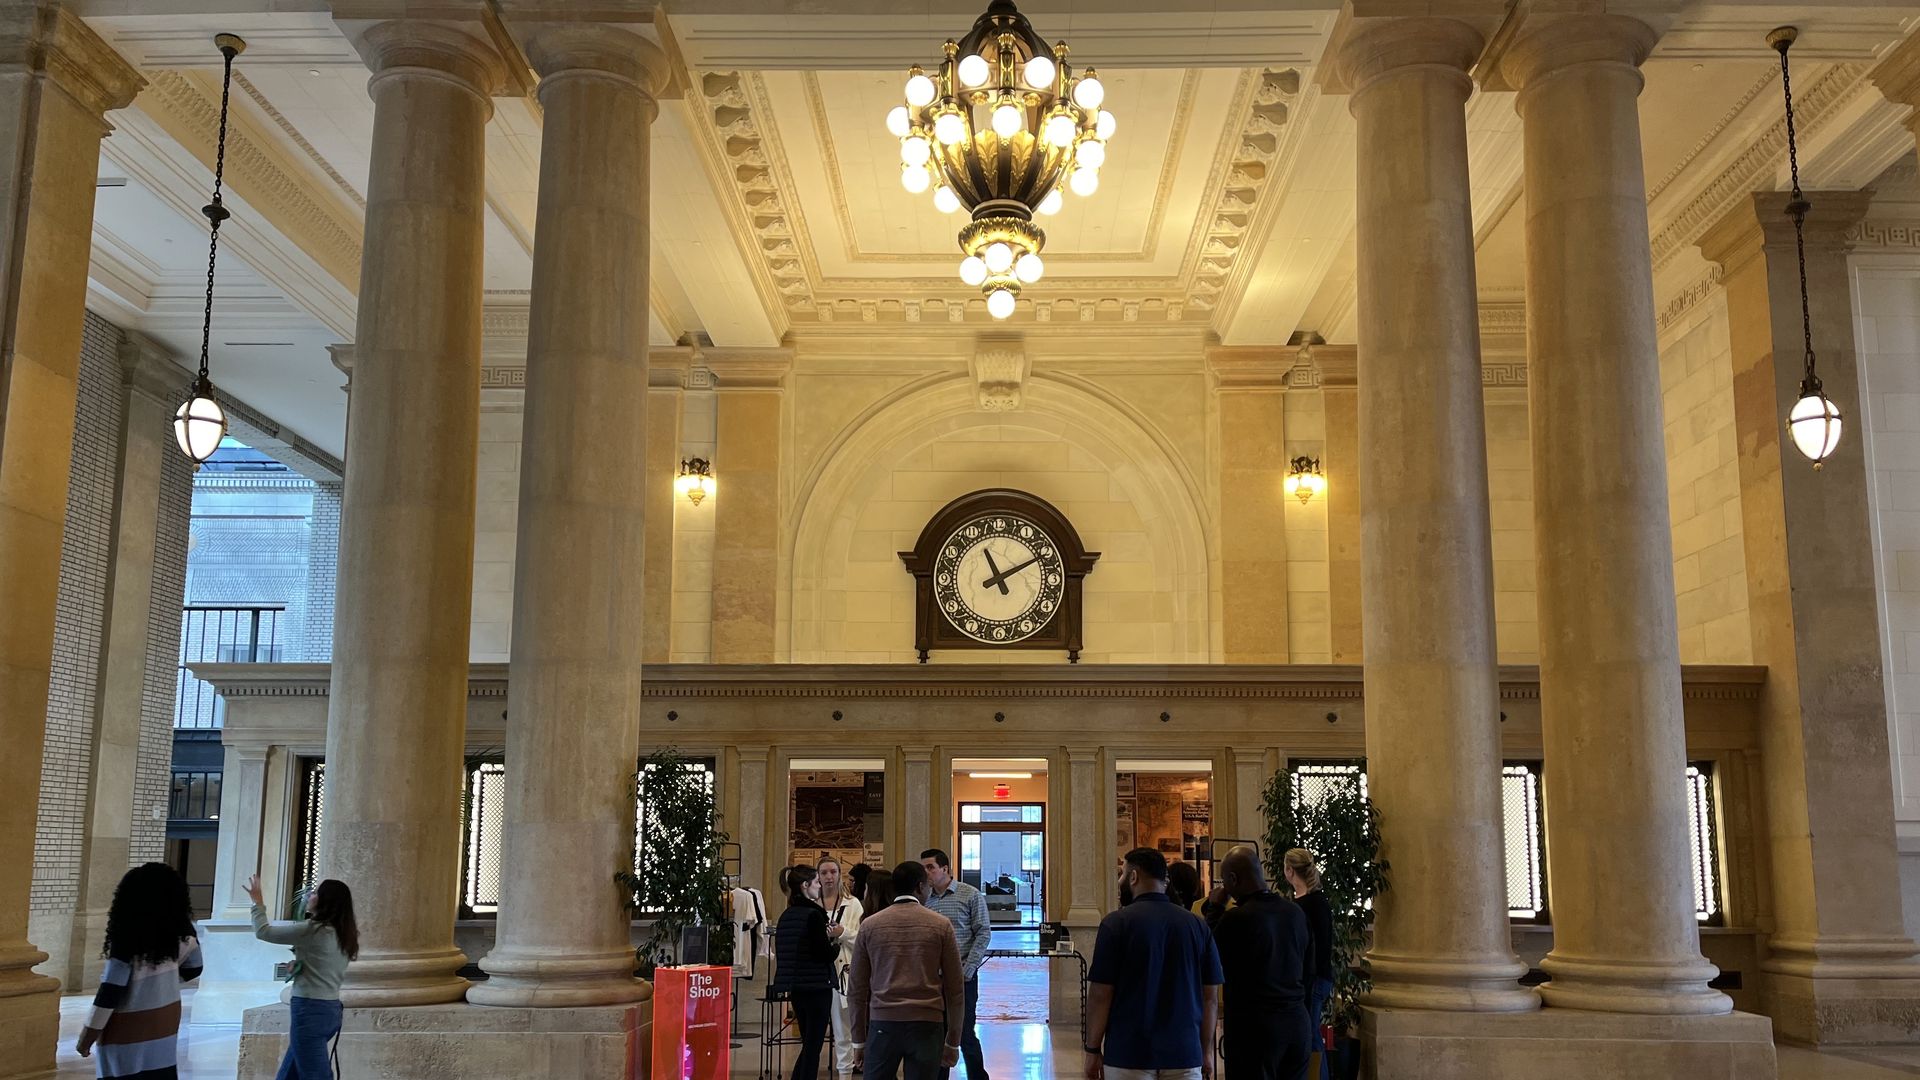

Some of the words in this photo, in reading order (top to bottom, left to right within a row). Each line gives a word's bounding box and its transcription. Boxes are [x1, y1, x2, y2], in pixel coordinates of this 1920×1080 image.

[995, 520, 1004, 528] 12
[967, 528, 977, 536] 11
[948, 548, 956, 556] 10
[1043, 547, 1050, 557] 2
[941, 575, 948, 584] 9
[1051, 575, 1057, 584] 3
[948, 602, 955, 610] 8
[1043, 602, 1050, 610] 4
[968, 622, 975, 631] 7
[1024, 622, 1030, 631] 5
[995, 628, 1002, 638] 6
[689, 974, 712, 985] The
[689, 986, 720, 999] Shop
